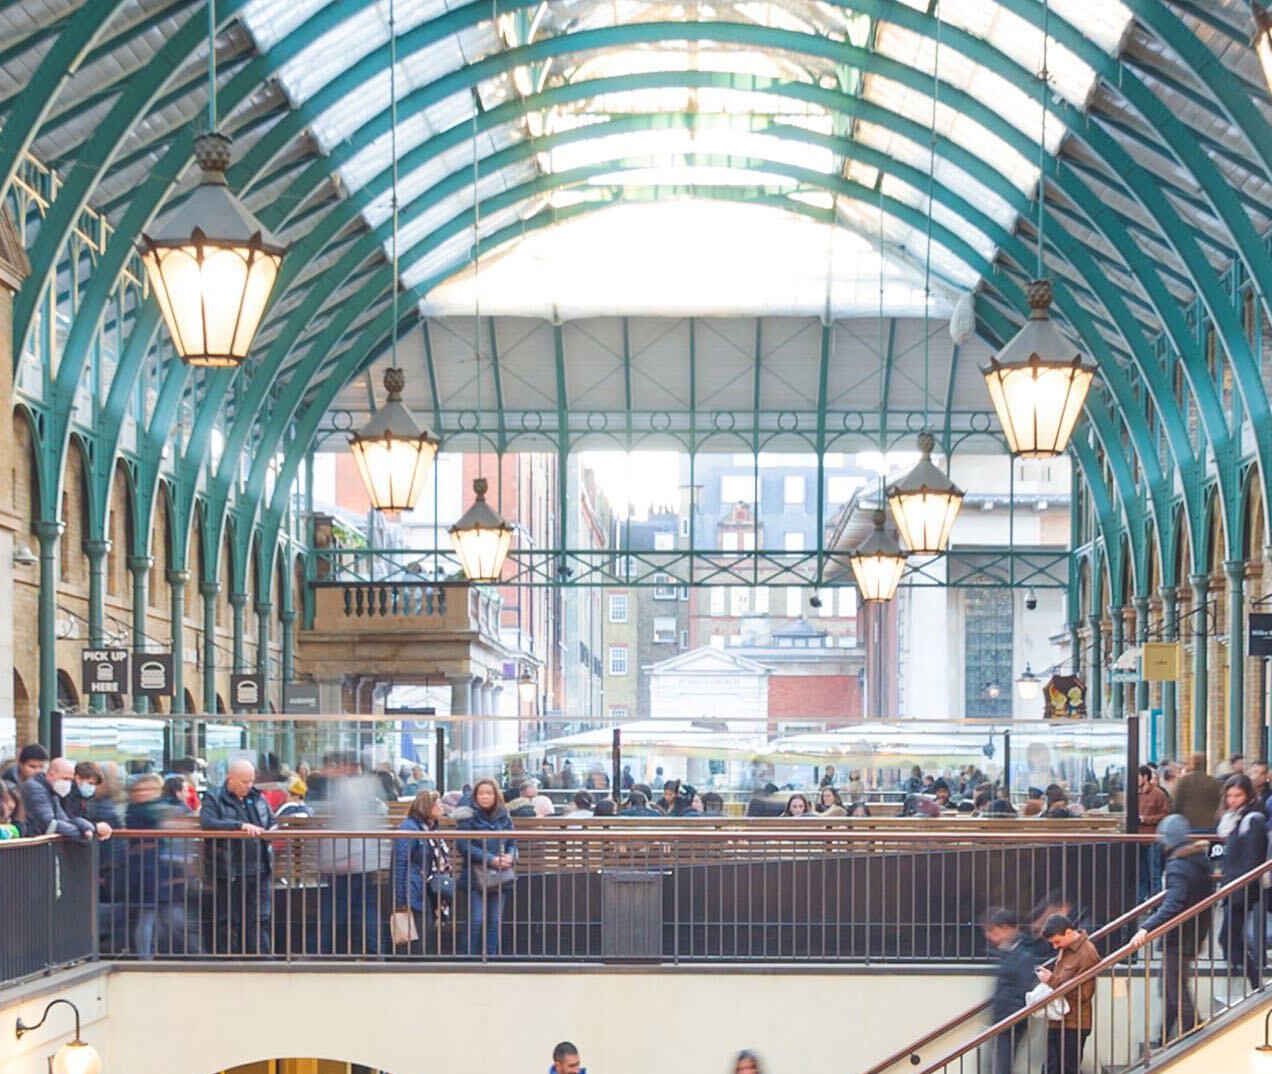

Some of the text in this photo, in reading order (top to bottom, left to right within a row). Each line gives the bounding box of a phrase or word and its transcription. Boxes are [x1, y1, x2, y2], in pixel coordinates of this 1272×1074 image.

[83, 651, 127, 662] PICK UP
[91, 682, 119, 692] HERE
